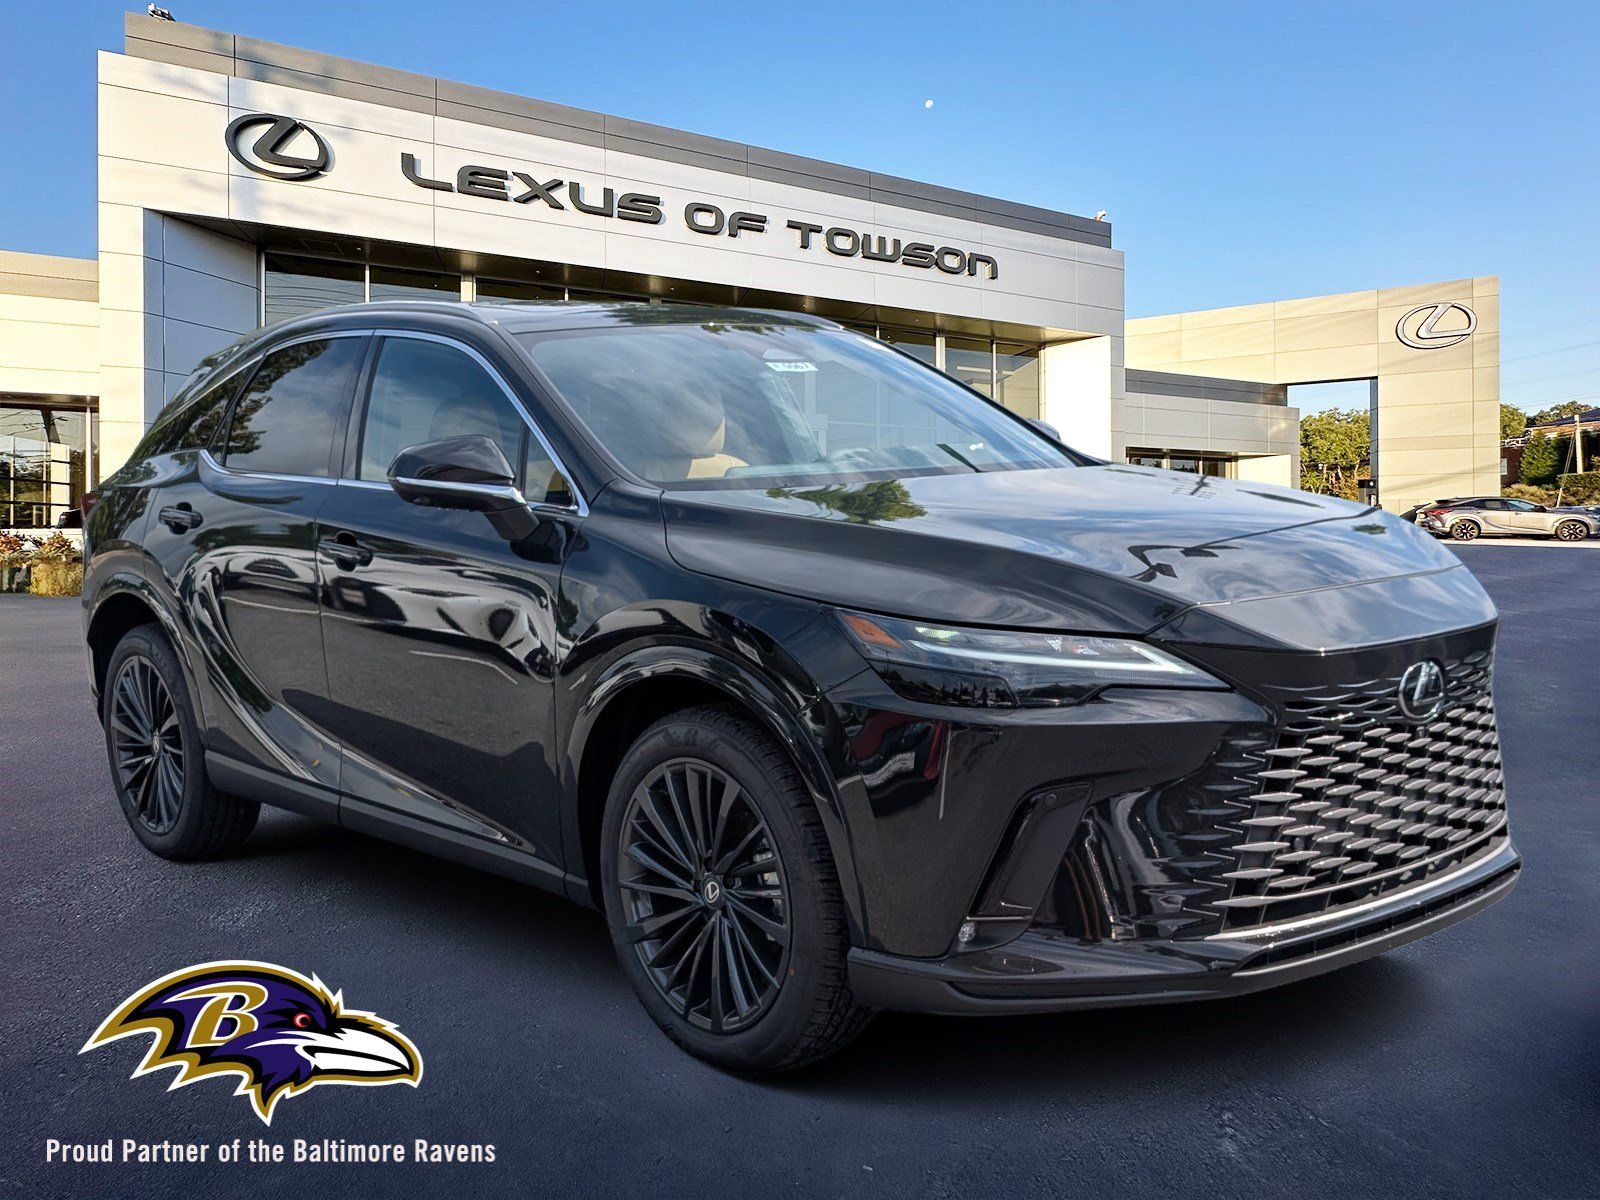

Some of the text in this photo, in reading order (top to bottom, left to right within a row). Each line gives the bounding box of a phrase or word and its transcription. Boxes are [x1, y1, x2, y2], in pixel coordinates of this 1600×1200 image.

[401, 152, 998, 280] LEXUS OF TOWSON
